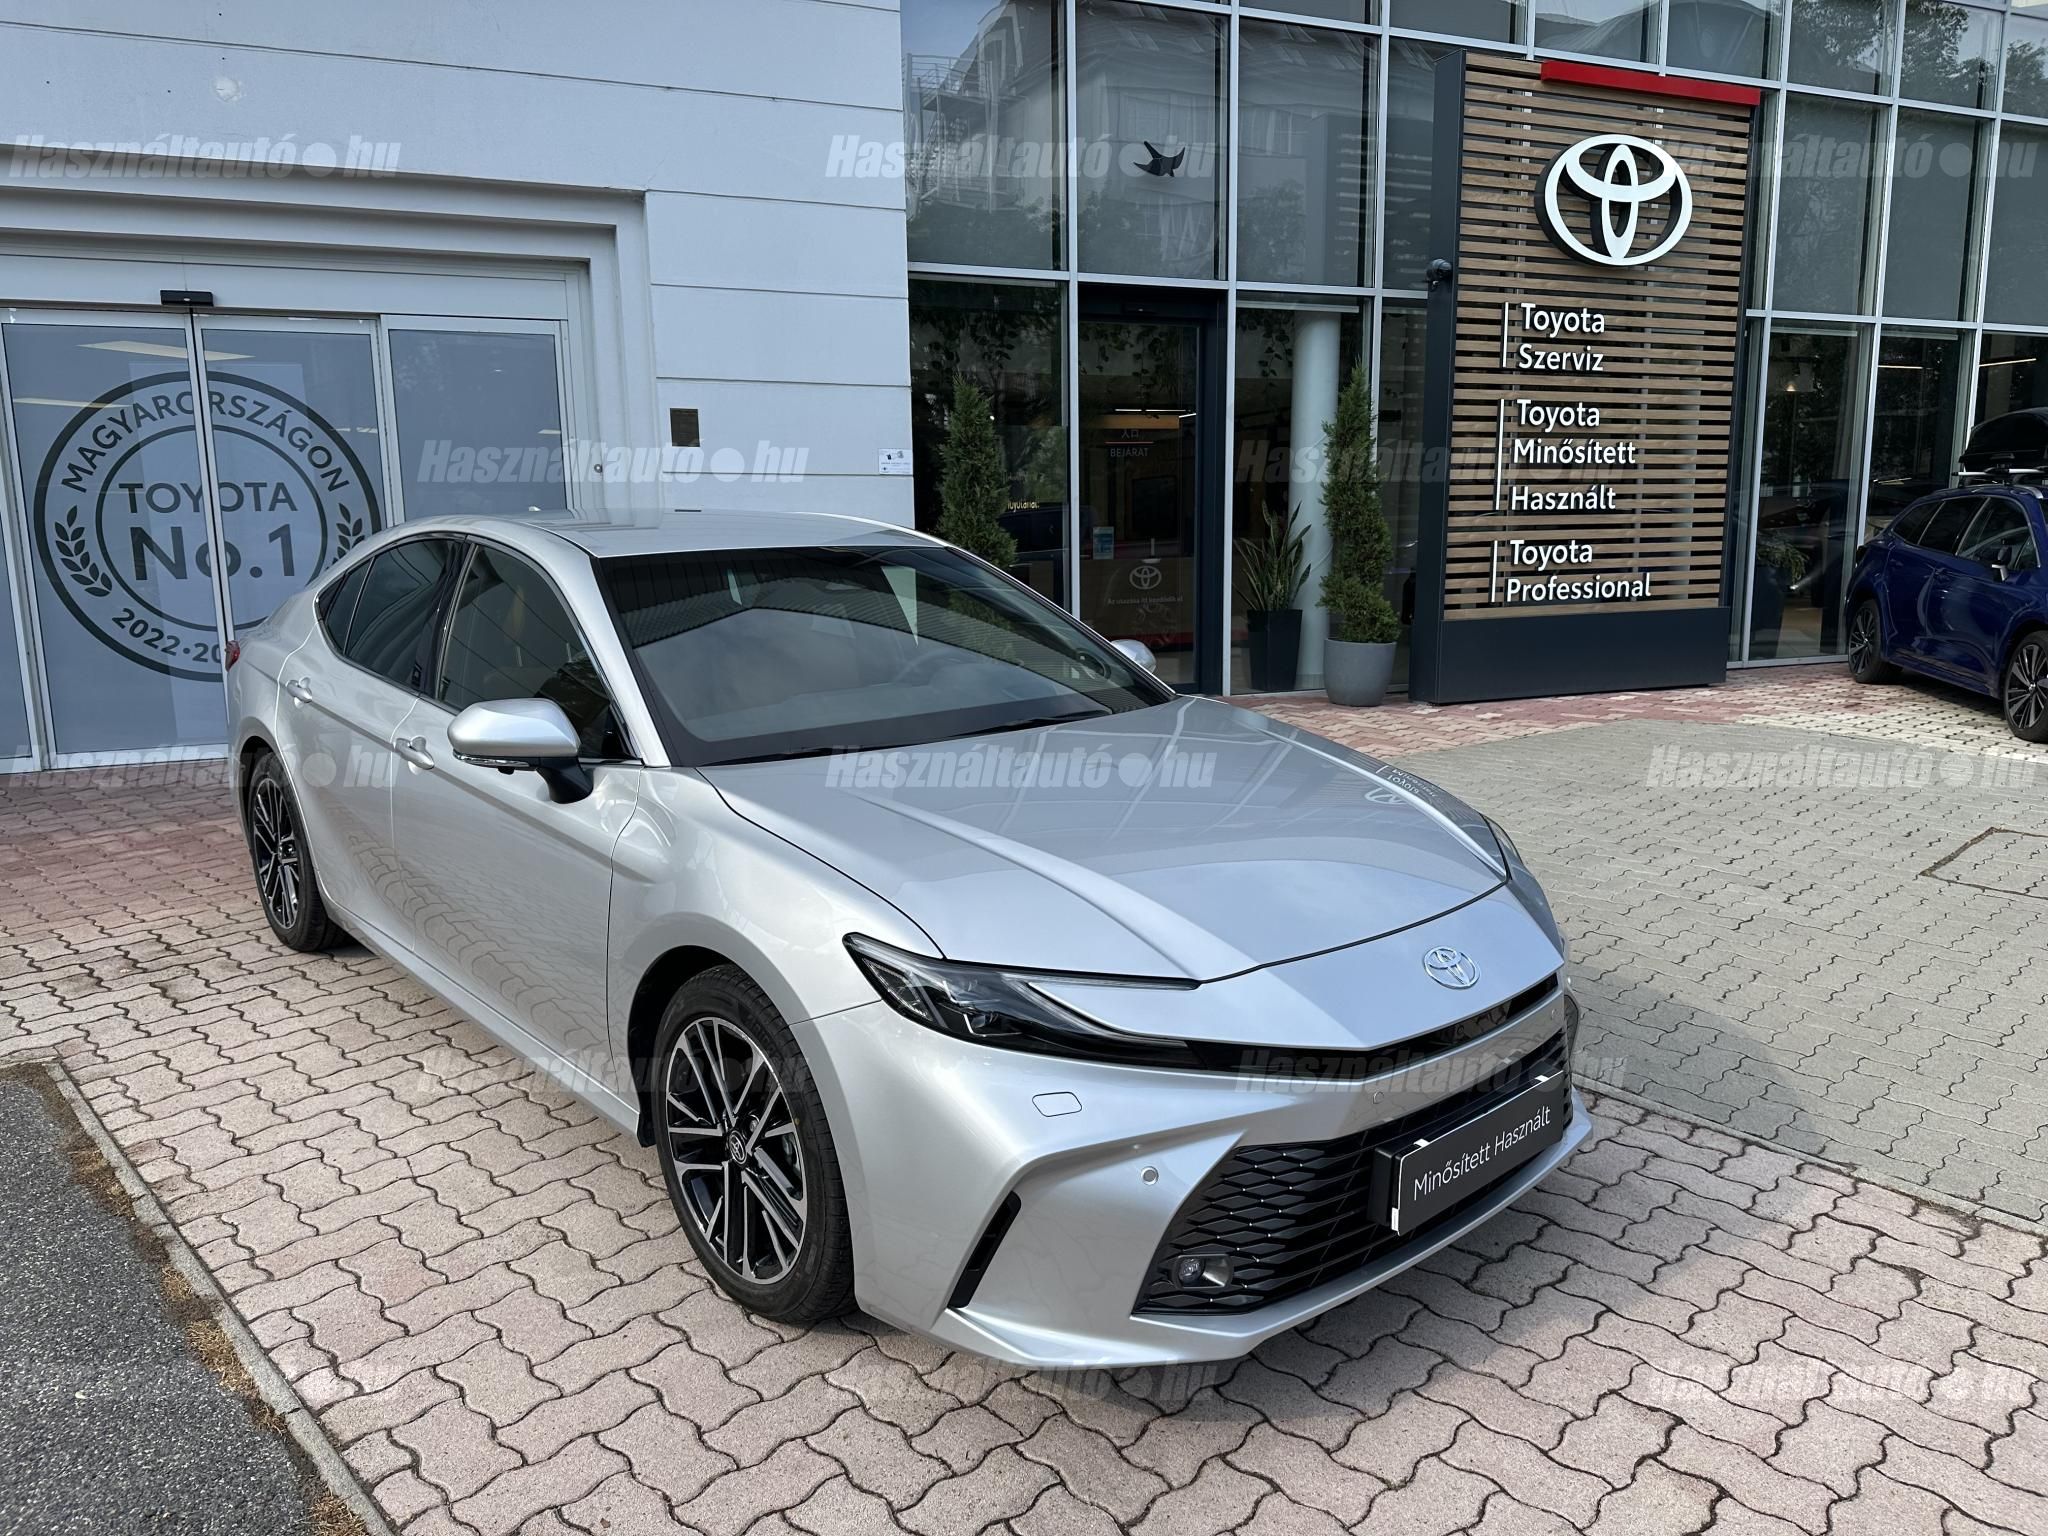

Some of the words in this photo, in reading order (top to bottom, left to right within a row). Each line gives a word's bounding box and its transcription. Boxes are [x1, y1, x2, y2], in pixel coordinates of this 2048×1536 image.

[1520, 302, 1605, 338] Toyota
[1518, 343, 1604, 372] Szerviz
[1516, 399, 1600, 433] Toyota
[61, 390, 350, 493] MAGYARORSZÁGON
[1513, 438, 1636, 464] Minősített
[118, 481, 298, 514] TOYOTA
[1511, 484, 1616, 510] Használt
[1509, 539, 1593, 572] Toyota
[1506, 572, 1651, 602] Professional
[1413, 1143, 1491, 1200] Minősített
[1494, 1105, 1551, 1156] Használt
